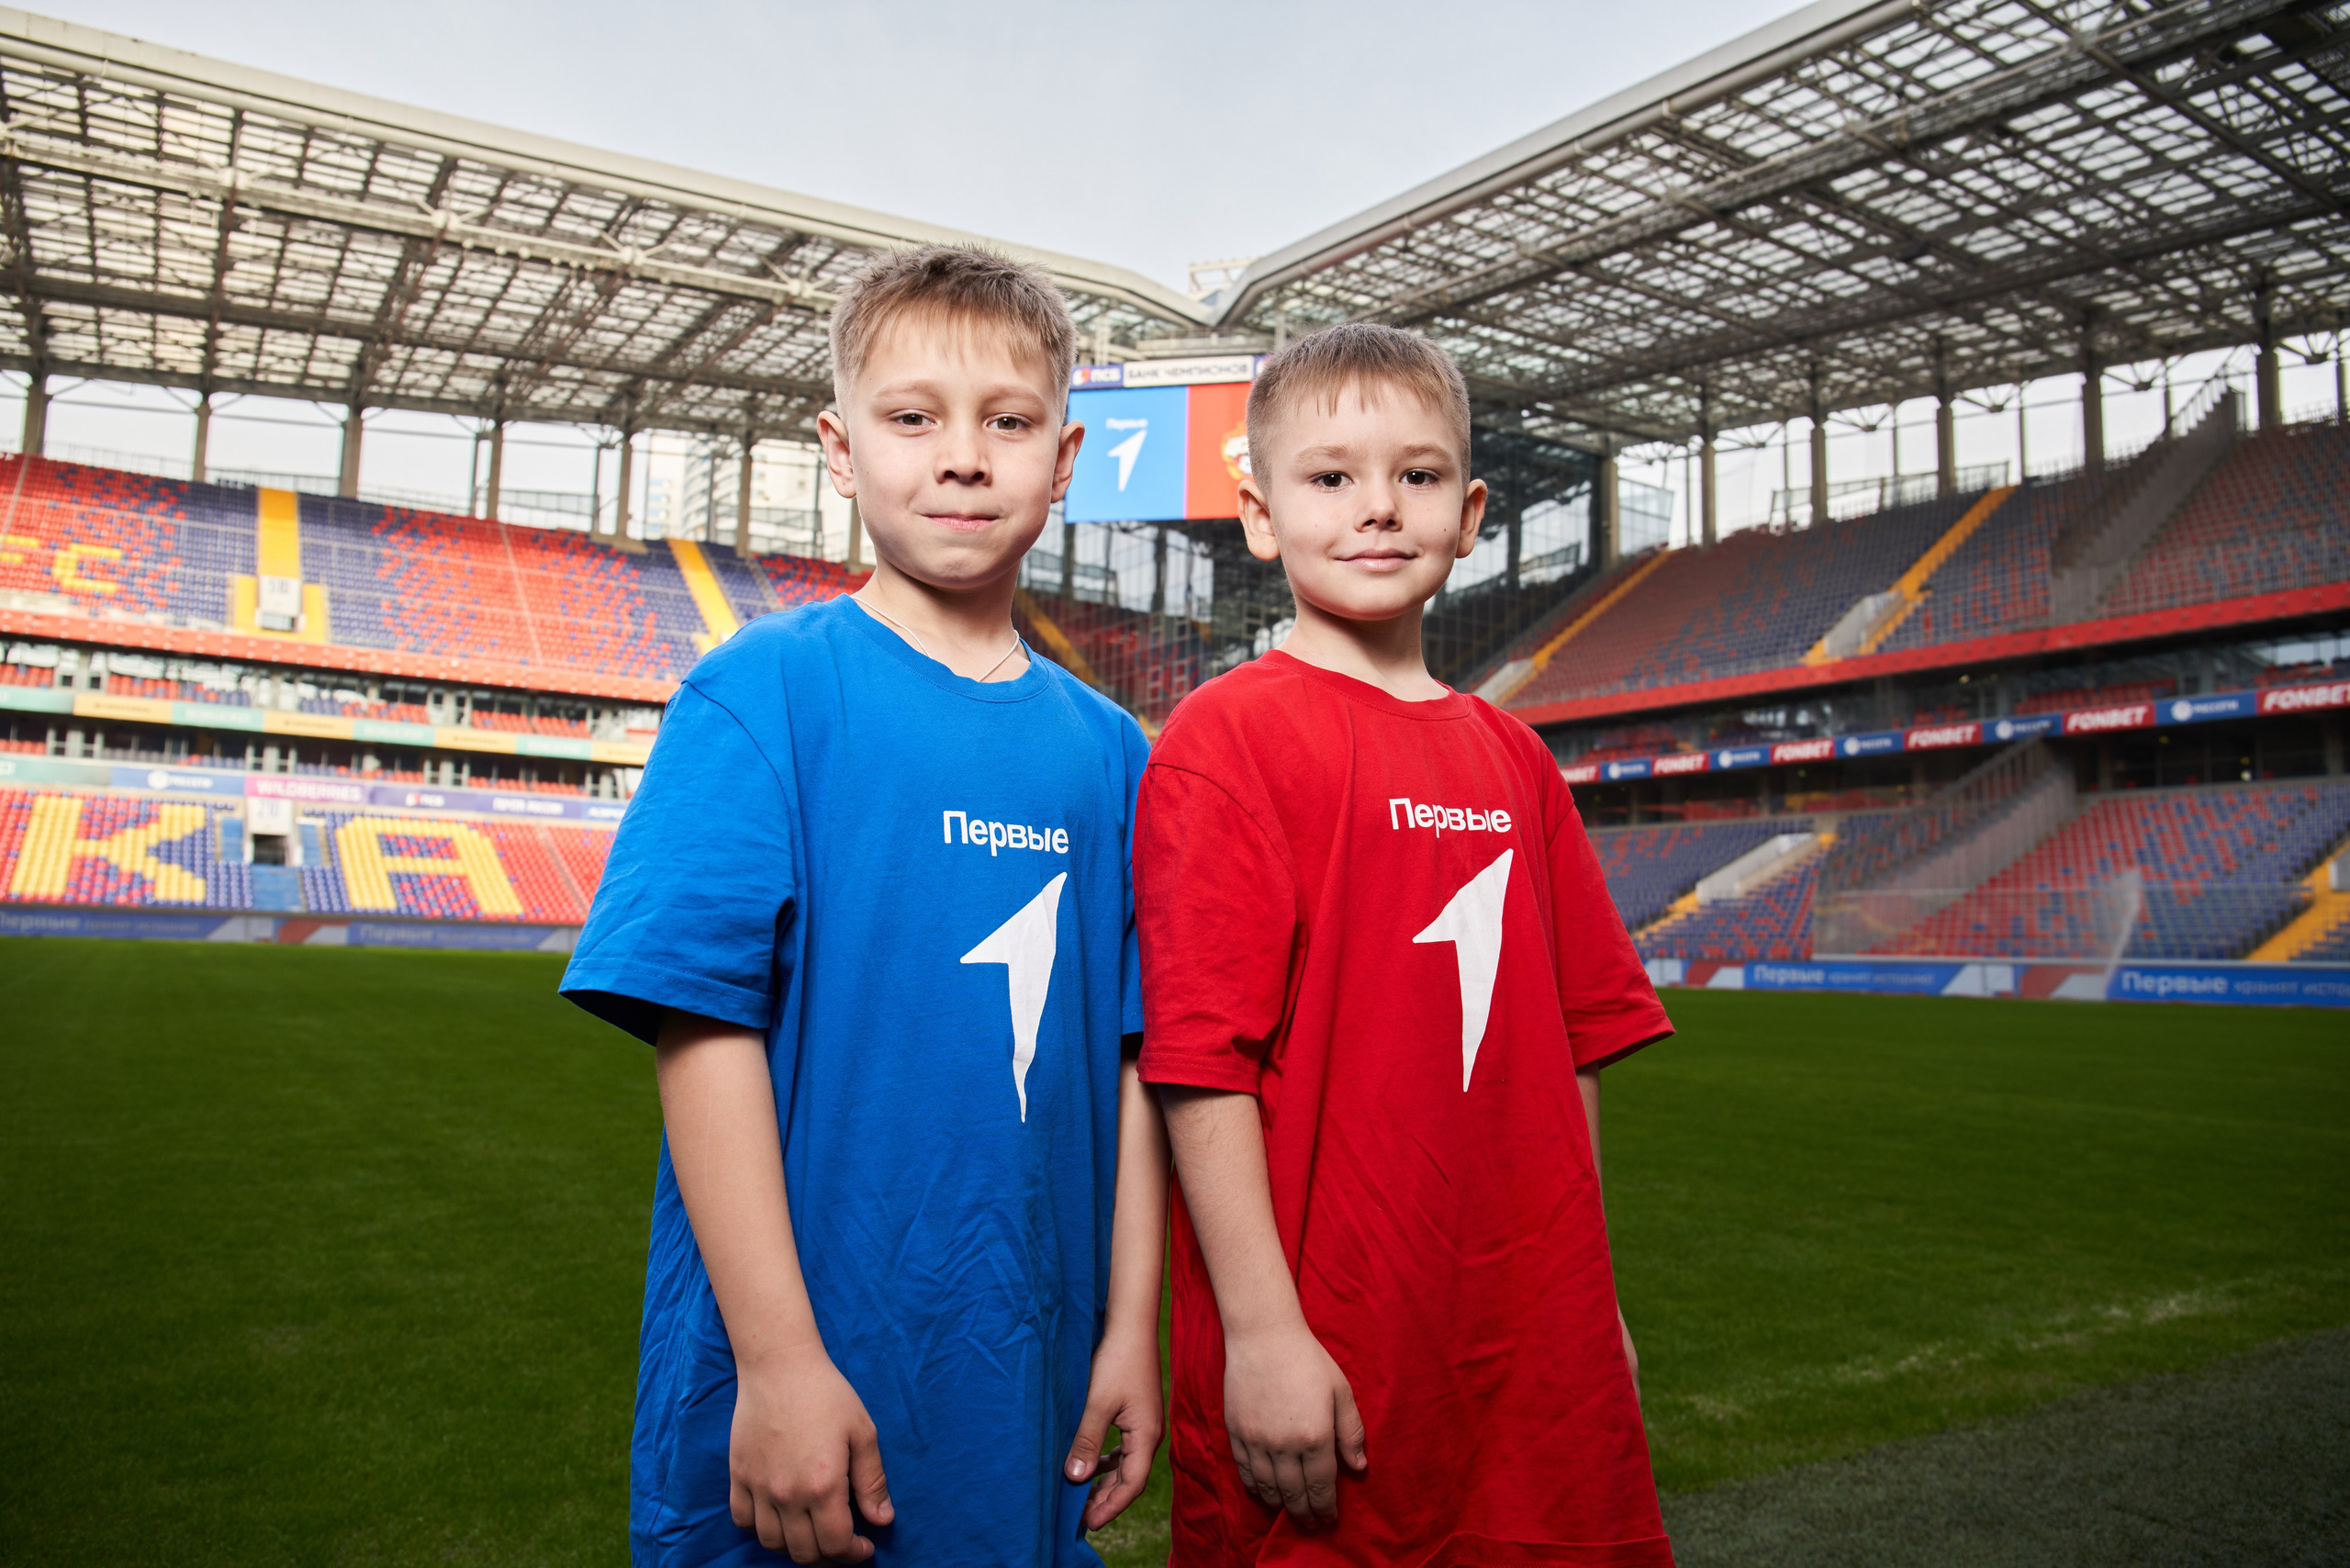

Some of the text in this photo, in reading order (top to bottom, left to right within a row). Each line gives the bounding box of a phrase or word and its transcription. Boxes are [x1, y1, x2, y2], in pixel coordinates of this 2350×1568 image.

[1128, 364, 1248, 379] БАНК ЧЕМПИОНОВ
[2066, 706, 2149, 732] FONBET
[1908, 724, 1976, 747] FONBET
[1774, 739, 1832, 761] FONBET
[1653, 753, 1706, 774] FONBET
[256, 778, 364, 802] WILDBERRIES
[1389, 797, 1513, 839] Первые
[943, 810, 1070, 857] Первые
[359, 923, 434, 942] Первые
[1753, 965, 1826, 987] Первые
[2121, 970, 2229, 997] Первые
